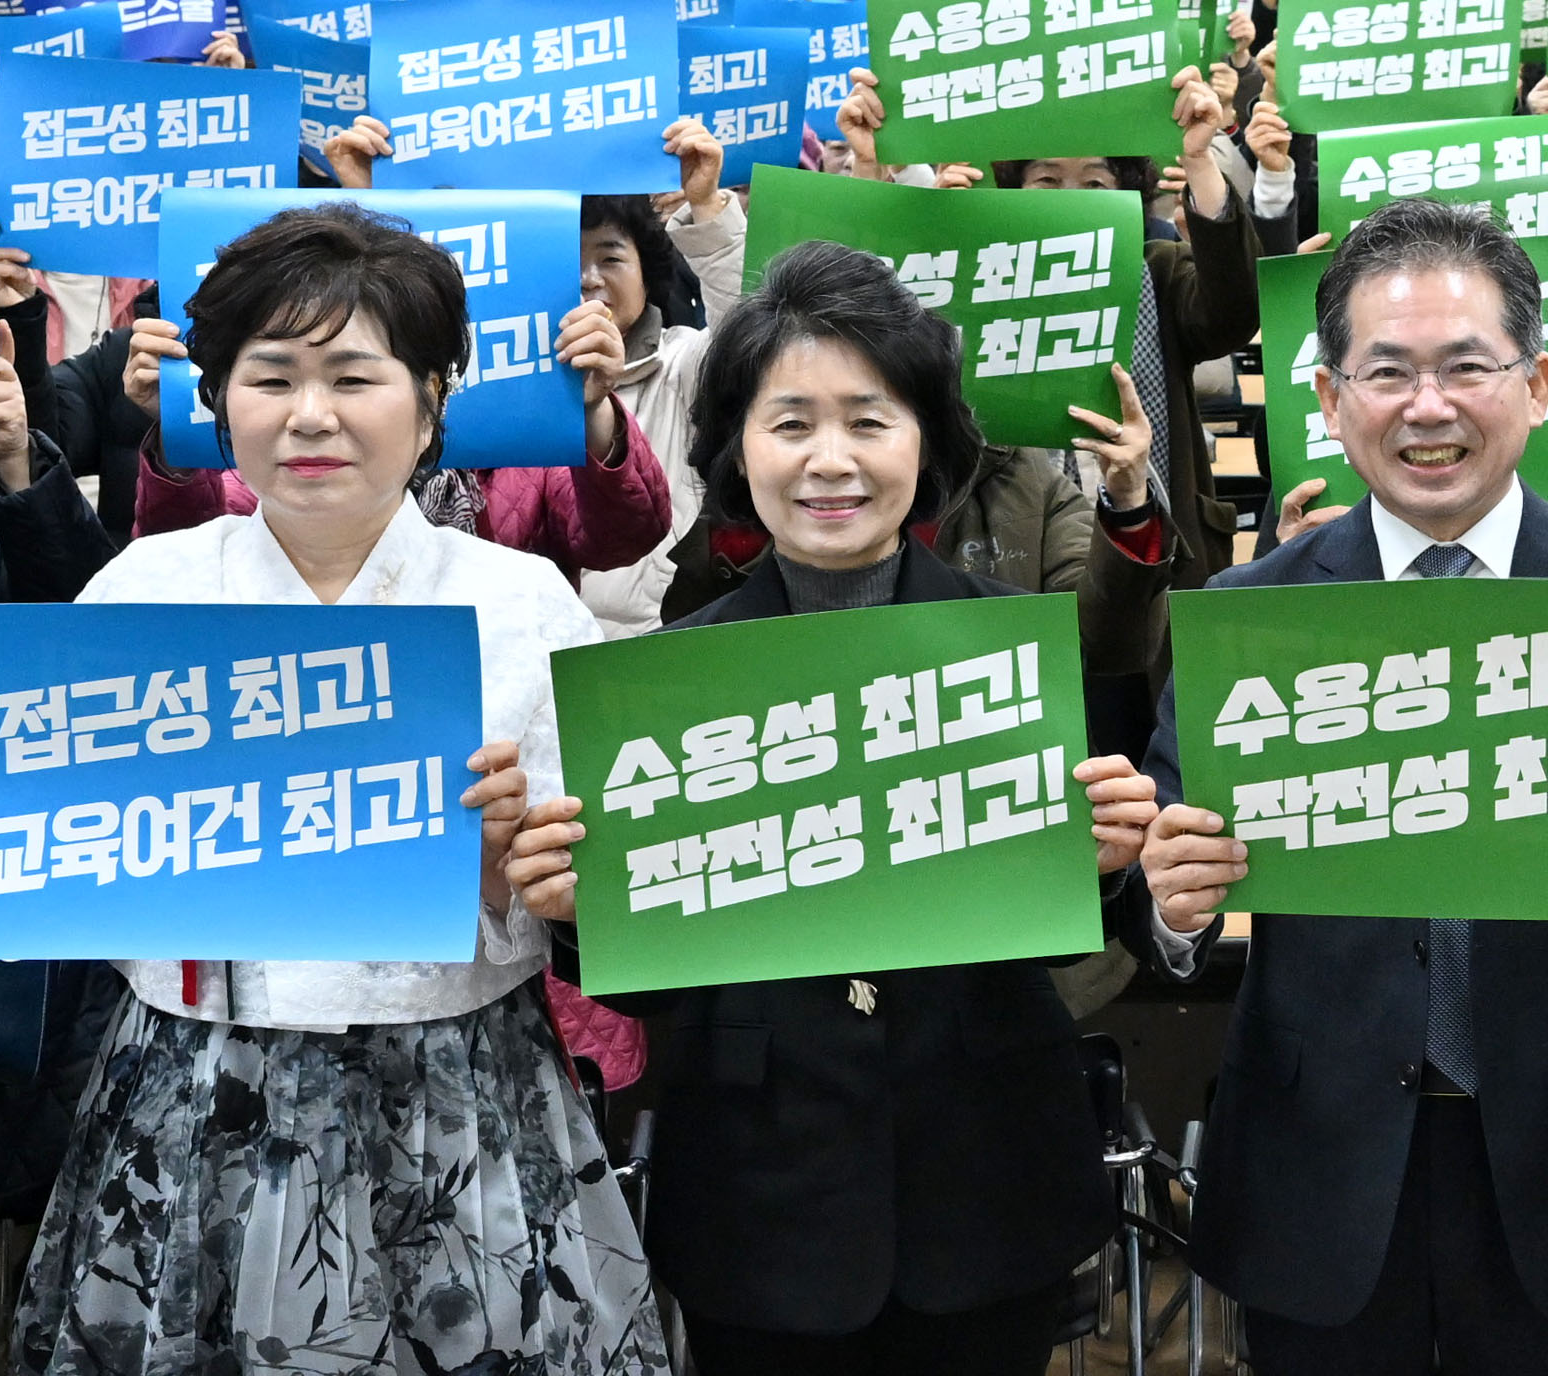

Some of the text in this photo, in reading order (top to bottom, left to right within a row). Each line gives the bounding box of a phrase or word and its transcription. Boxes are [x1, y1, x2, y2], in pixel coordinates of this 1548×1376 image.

[397, 15, 627, 96] 접근성 최고!
[1292, 1, 1410, 52] 수용성
[688, 48, 768, 96] 최고!
[901, 54, 1045, 126] 작전성
[1056, 30, 1167, 99] 최고!
[1297, 52, 1415, 102] 작전성
[1422, 42, 1512, 92] 최고!
[20, 101, 147, 162] 접근성
[157, 94, 251, 148] 최고!
[390, 92, 553, 164] 교육여건
[562, 75, 658, 132] 최고!
[973, 226, 1116, 303] 최고!
[973, 304, 1122, 380] 최고!
[228, 640, 393, 741] 최고!
[601, 640, 1045, 821] 수용성 최고!
[1211, 644, 1455, 758] 수용성
[279, 754, 447, 860] 최고!
[626, 743, 1069, 918] 작전성 최고!
[1230, 746, 1471, 854] 작전성
